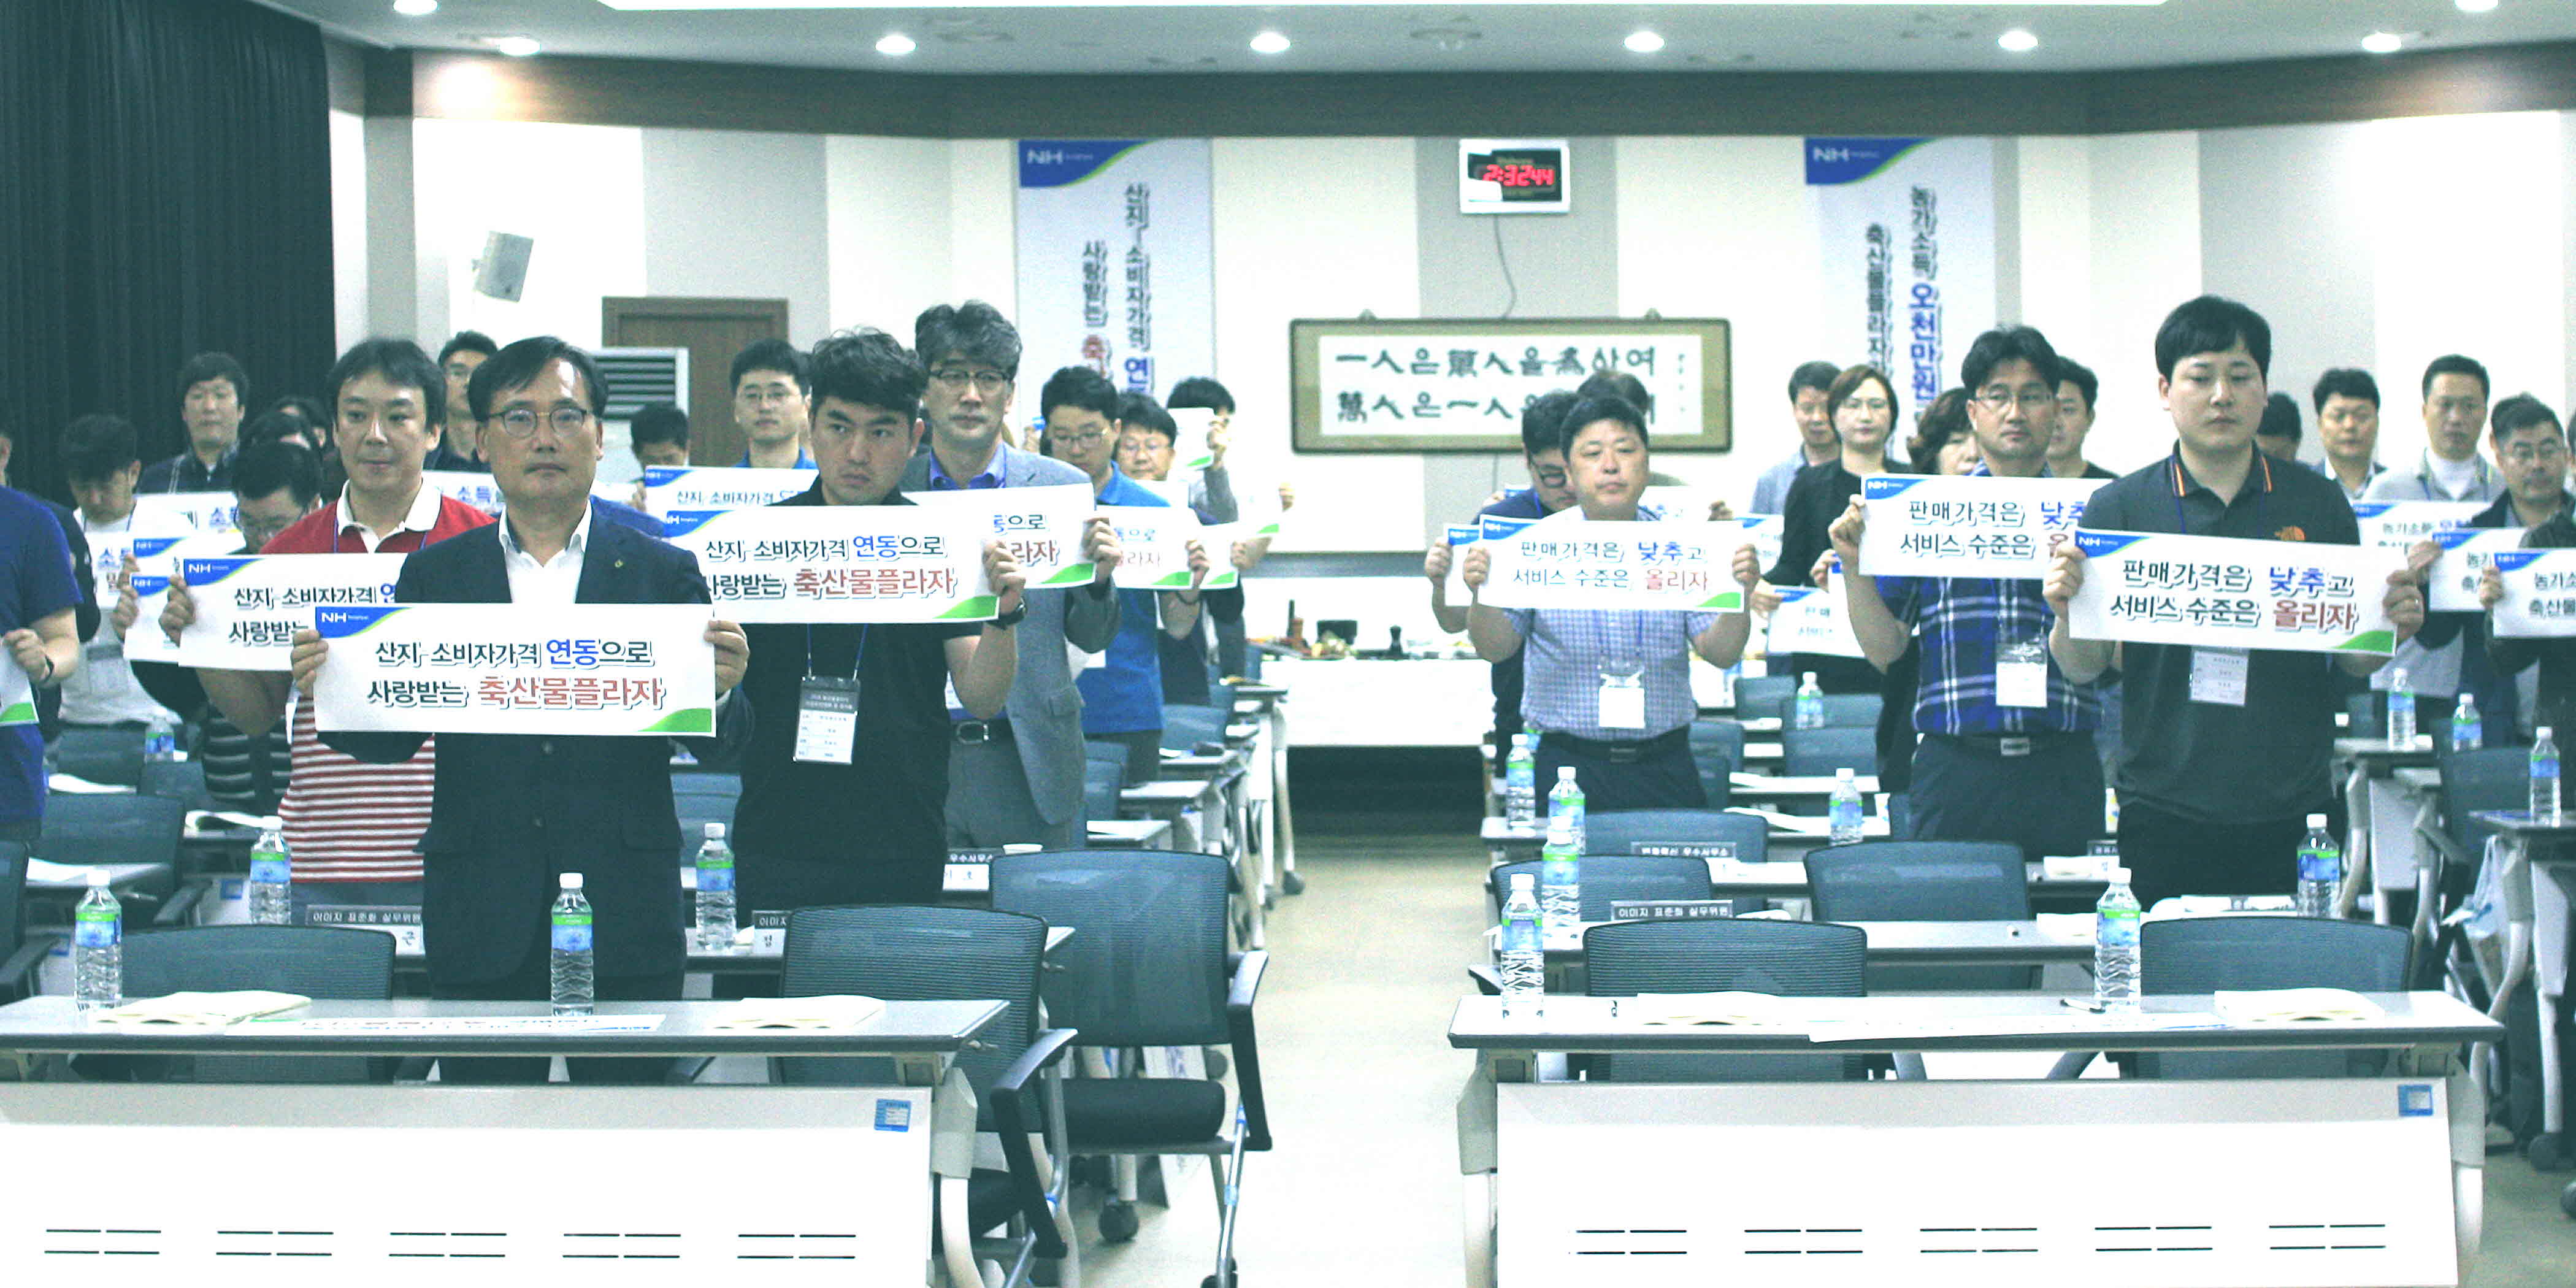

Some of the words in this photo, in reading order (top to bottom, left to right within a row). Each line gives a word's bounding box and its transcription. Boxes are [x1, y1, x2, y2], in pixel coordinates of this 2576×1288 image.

[1027, 149, 1063, 164] NH
[1814, 147, 1849, 161] NH
[1909, 500, 2023, 526] 판매가격은
[753, 539, 848, 561] 소비자가격
[853, 535, 946, 559] 연동으로
[1521, 541, 1623, 561] 판매가격은
[1638, 542, 1706, 562] 낮추고
[1900, 533, 1963, 556] 서비스
[1968, 534, 2034, 558] 수준은
[2079, 537, 2101, 546] NH
[188, 563, 212, 573] NH
[2123, 559, 2251, 591] 판매가격은
[2269, 566, 2353, 597] 낮추고
[794, 568, 956, 598] 축산물플라자
[1513, 569, 1566, 586] 서비스
[1575, 570, 1629, 589] 수준은
[1645, 569, 1708, 591] 올리자
[282, 586, 375, 604] 소비자가격
[321, 612, 347, 623] NH
[2110, 595, 2182, 620] 서비스
[2186, 597, 2260, 625] 수준은
[2272, 599, 2358, 631] 올리자
[431, 642, 540, 667] 소비자가격
[546, 638, 653, 667] 연동으로
[367, 680, 467, 707] 사랑받는
[477, 675, 665, 708] 축산물플라자
[313, 911, 343, 922] 이미지
[1618, 907, 1649, 918] 이미지
